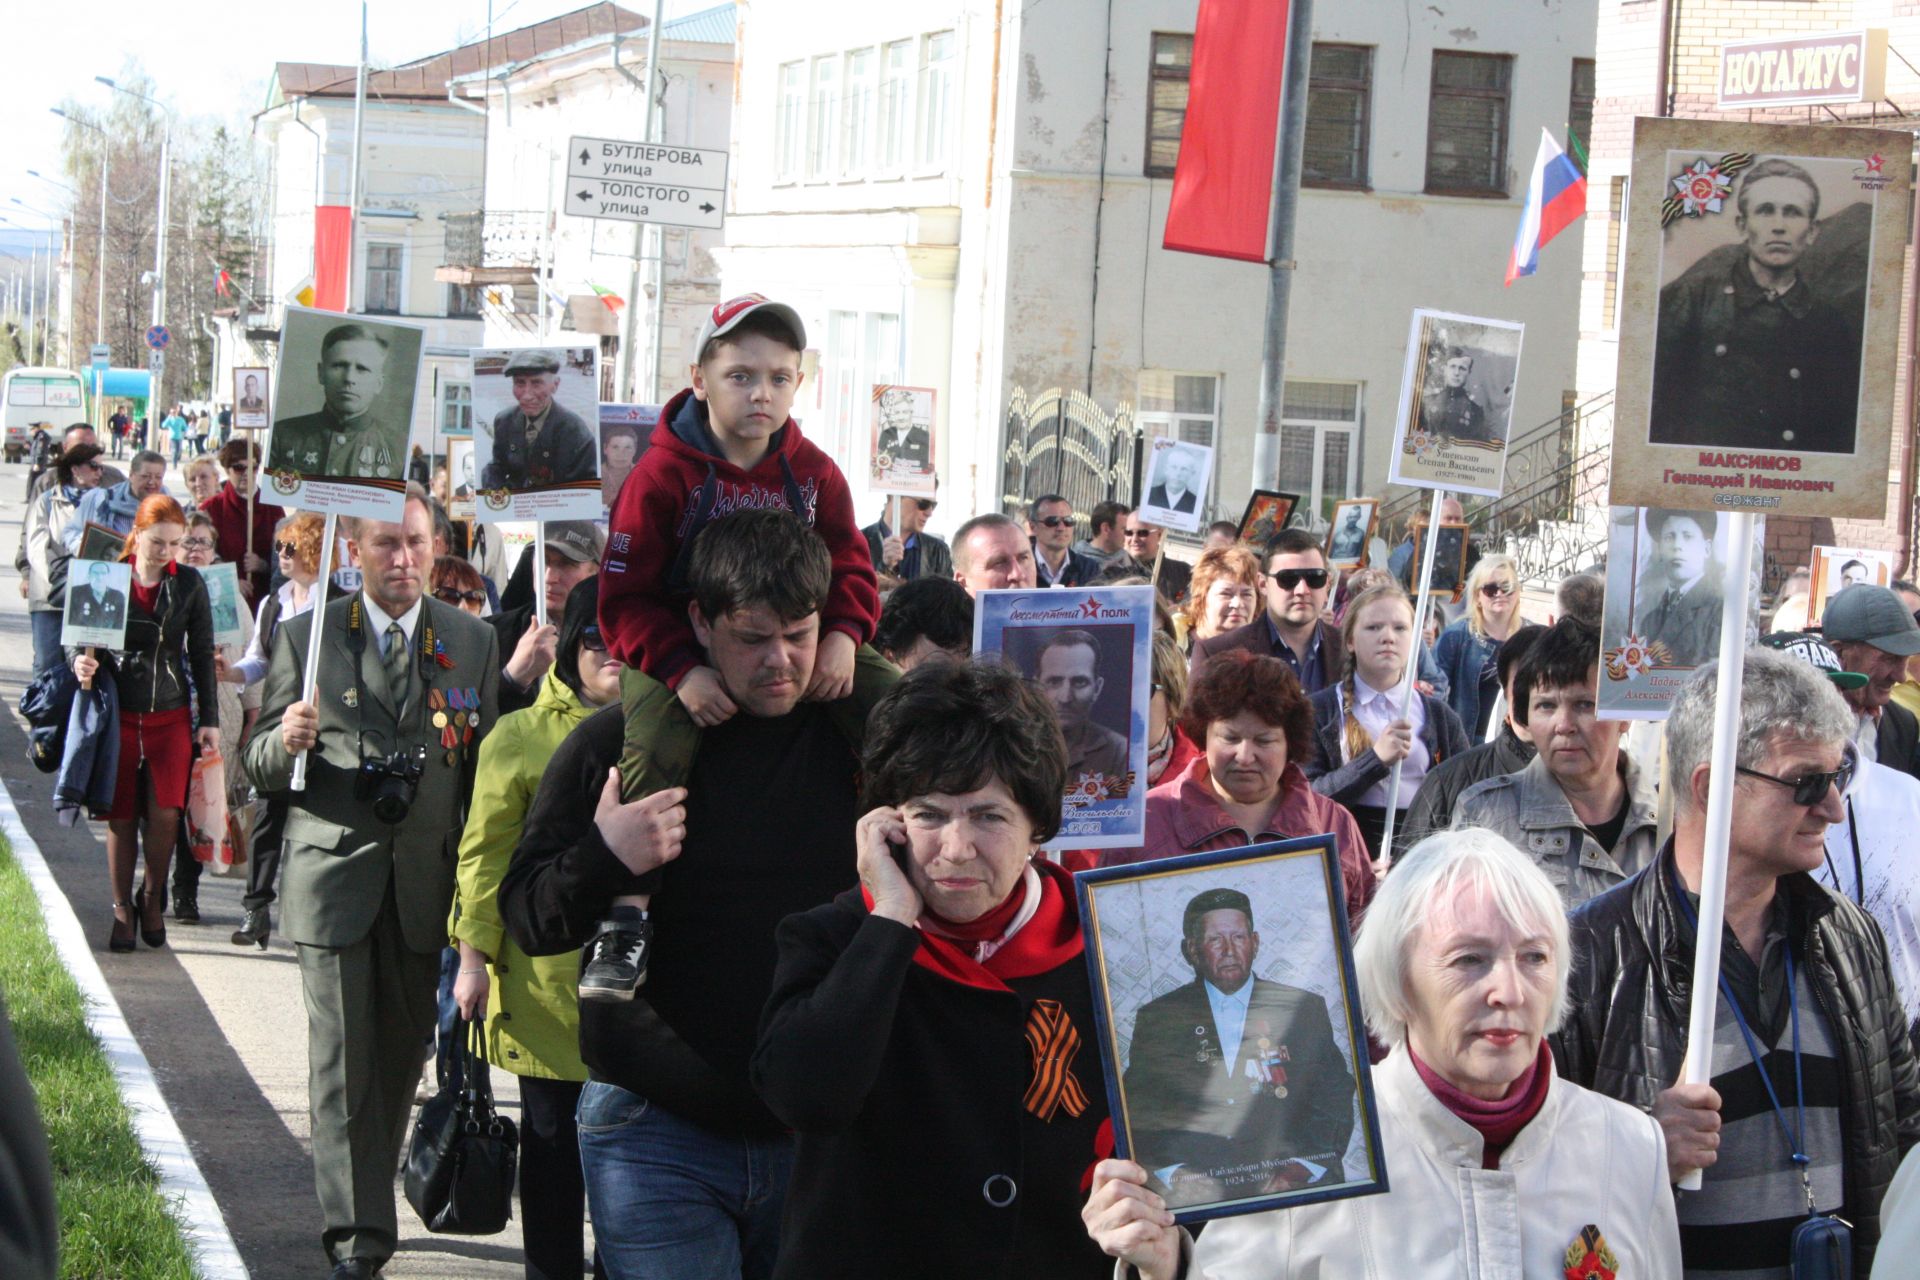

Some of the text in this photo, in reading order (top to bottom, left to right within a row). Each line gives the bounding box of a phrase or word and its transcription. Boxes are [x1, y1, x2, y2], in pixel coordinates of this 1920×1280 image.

[1725, 43, 1858, 96] НОТАРИУС
[602, 143, 703, 166] БУТЛЕРОВА
[603, 162, 652, 177] улица
[601, 182, 690, 203] ТОЛСТОГО
[600, 201, 649, 216] улица
[1417, 456, 1495, 474] Степан Васильевич
[1699, 452, 1802, 472] МАКСИМОВ
[1663, 469, 1834, 492] Геннадий Иванович
[1714, 493, 1781, 508] сержант
[350, 601, 359, 628] Nikon
[425, 628, 433, 655] Nikon
